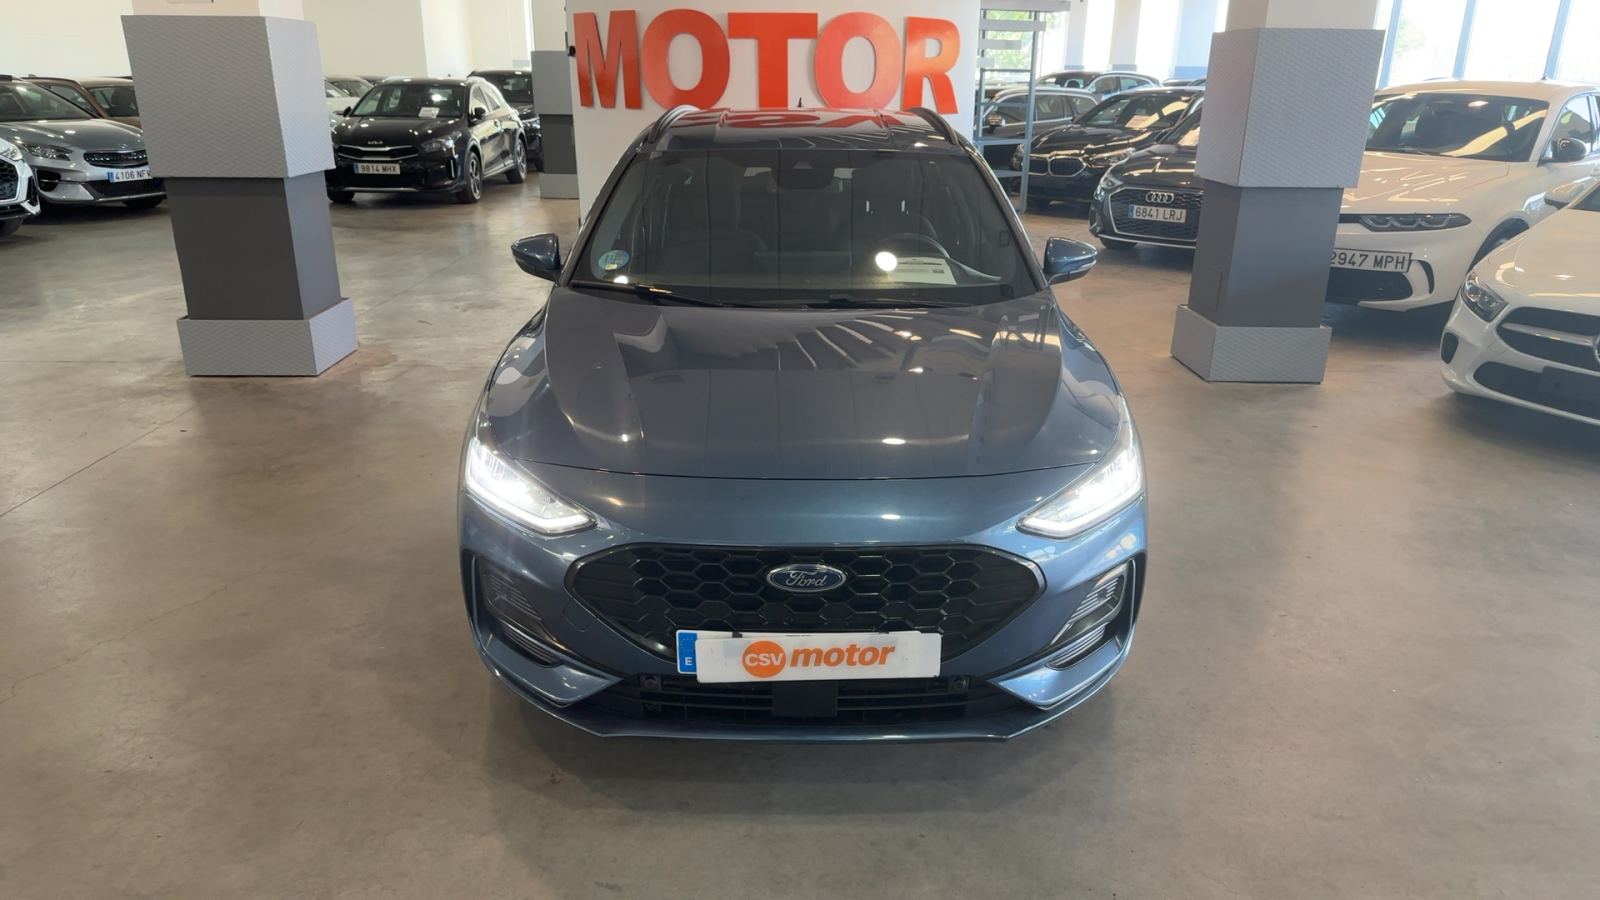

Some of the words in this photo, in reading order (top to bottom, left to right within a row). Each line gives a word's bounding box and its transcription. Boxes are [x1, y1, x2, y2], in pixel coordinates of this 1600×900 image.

[573, 8, 961, 115] MOTOR
[115, 170, 135, 180] 4106
[360, 164, 381, 173] 9814
[1135, 206, 1159, 219] 6841
[1162, 209, 1183, 221] LRJ
[1331, 251, 1369, 267] 2947
[1373, 254, 1406, 270] MPH
[785, 570, 829, 587] Ford
[684, 656, 693, 667] E
[744, 652, 784, 667] CSV
[790, 643, 896, 668] motor
